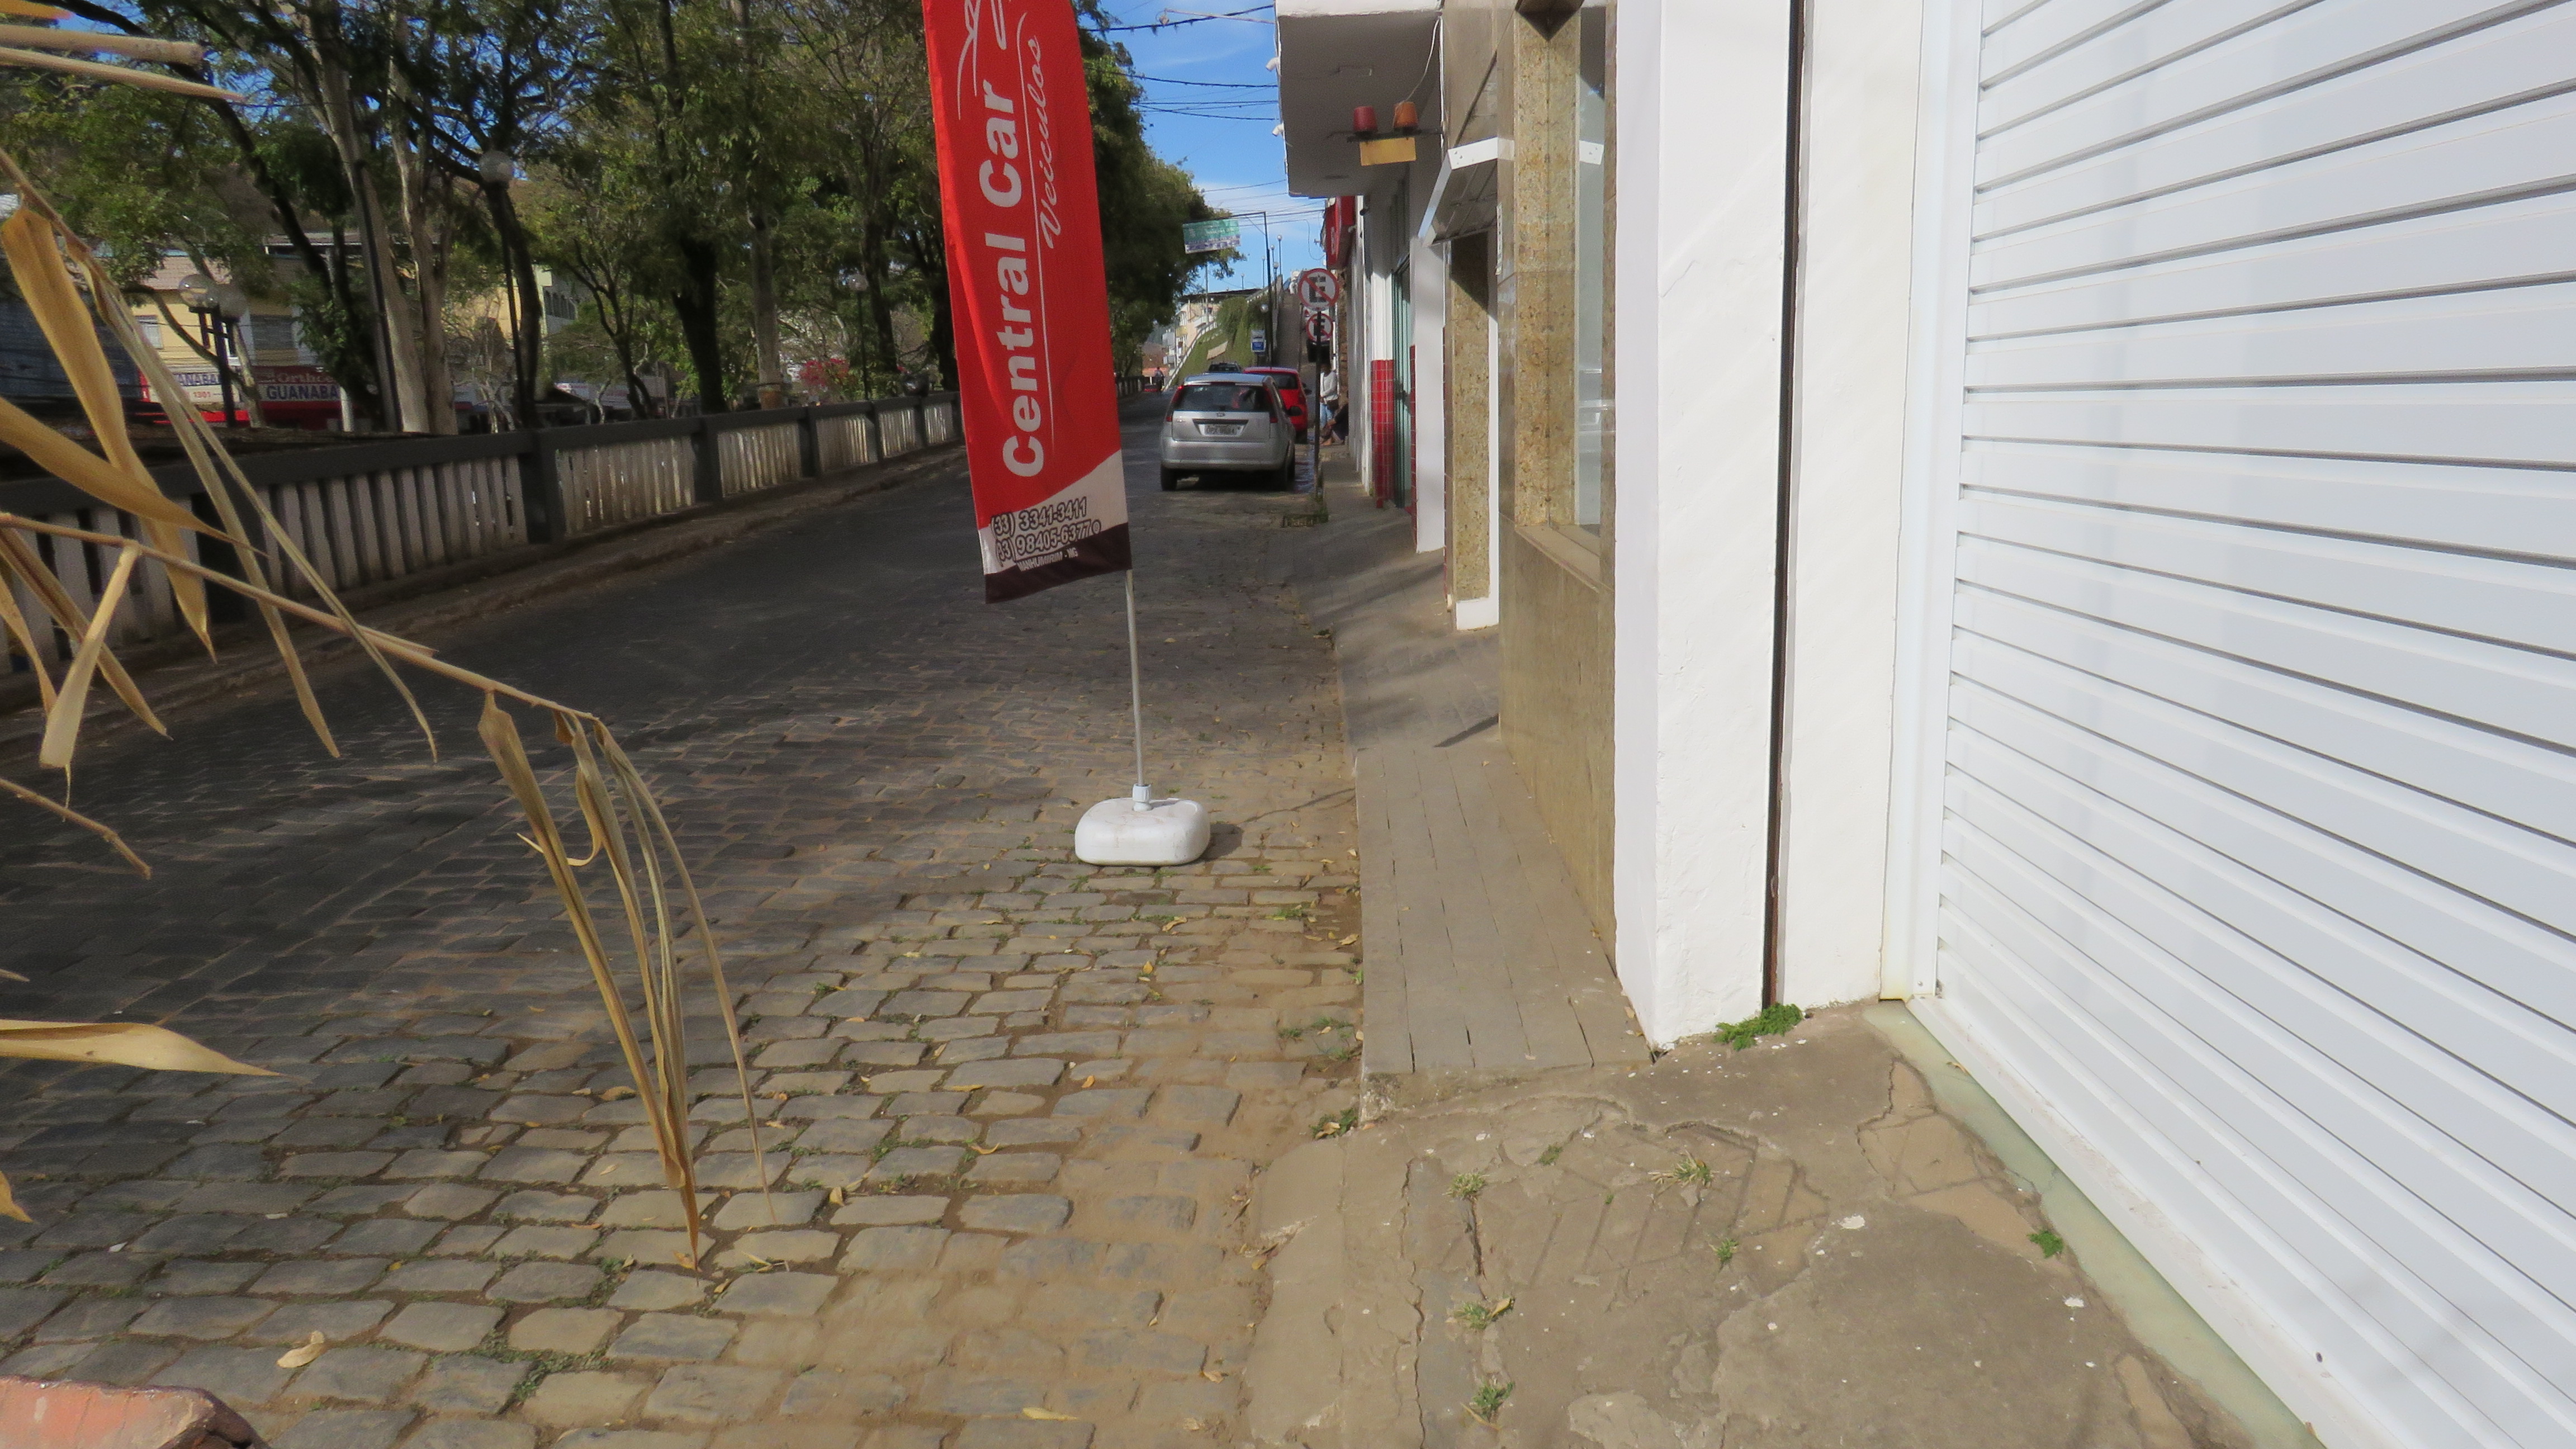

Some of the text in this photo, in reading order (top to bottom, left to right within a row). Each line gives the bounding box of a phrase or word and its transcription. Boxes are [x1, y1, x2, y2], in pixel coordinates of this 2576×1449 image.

[979, 79, 1044, 477] Central Car
[267, 385, 339, 400] GUANABA
[991, 496, 1087, 541] (33) 3341-3411
